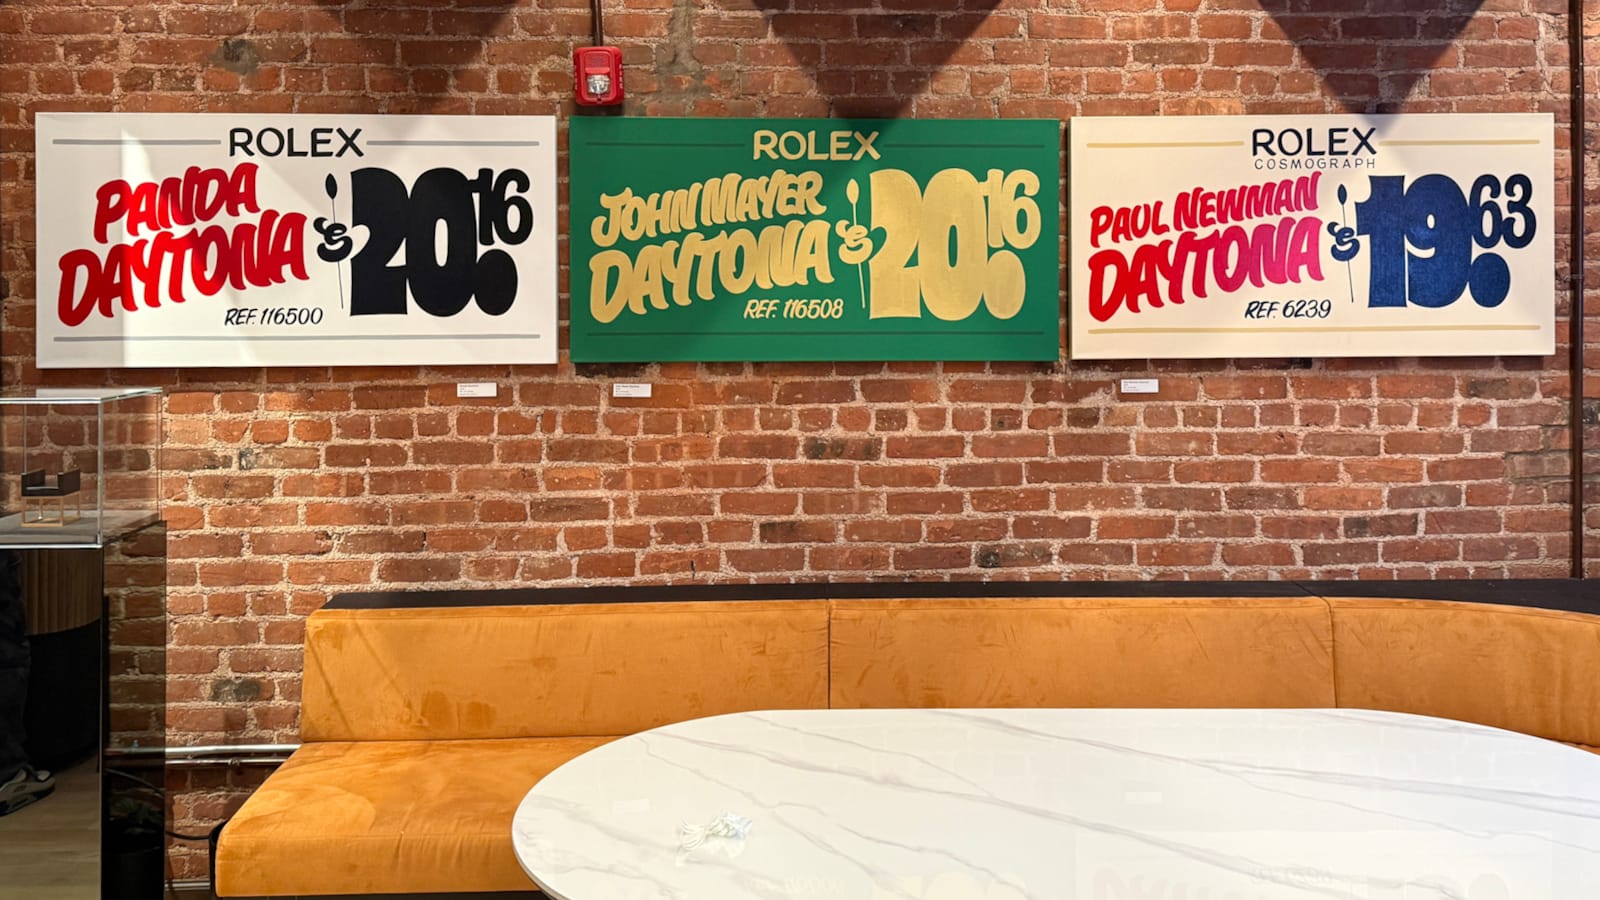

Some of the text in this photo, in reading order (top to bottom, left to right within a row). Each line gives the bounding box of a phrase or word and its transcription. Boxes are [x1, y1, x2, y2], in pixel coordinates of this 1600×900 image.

[229, 128, 364, 158] ROLEX
[753, 130, 881, 161] ROLEX
[1252, 127, 1378, 157] ROLEX
[1254, 158, 1376, 170] COSMOGRAPH
[94, 162, 259, 244] PANDA
[590, 169, 827, 248] JOHN MAYER
[1090, 171, 1322, 248] PAUL NEWMAN
[57, 209, 310, 327] DAYTONA
[588, 219, 835, 324] DAYTONA
[1087, 216, 1325, 322] DAYTONA
[224, 308, 323, 327] REF. 116500
[743, 298, 844, 319] REF. 116508
[1244, 299, 1332, 319] REF. 6239
